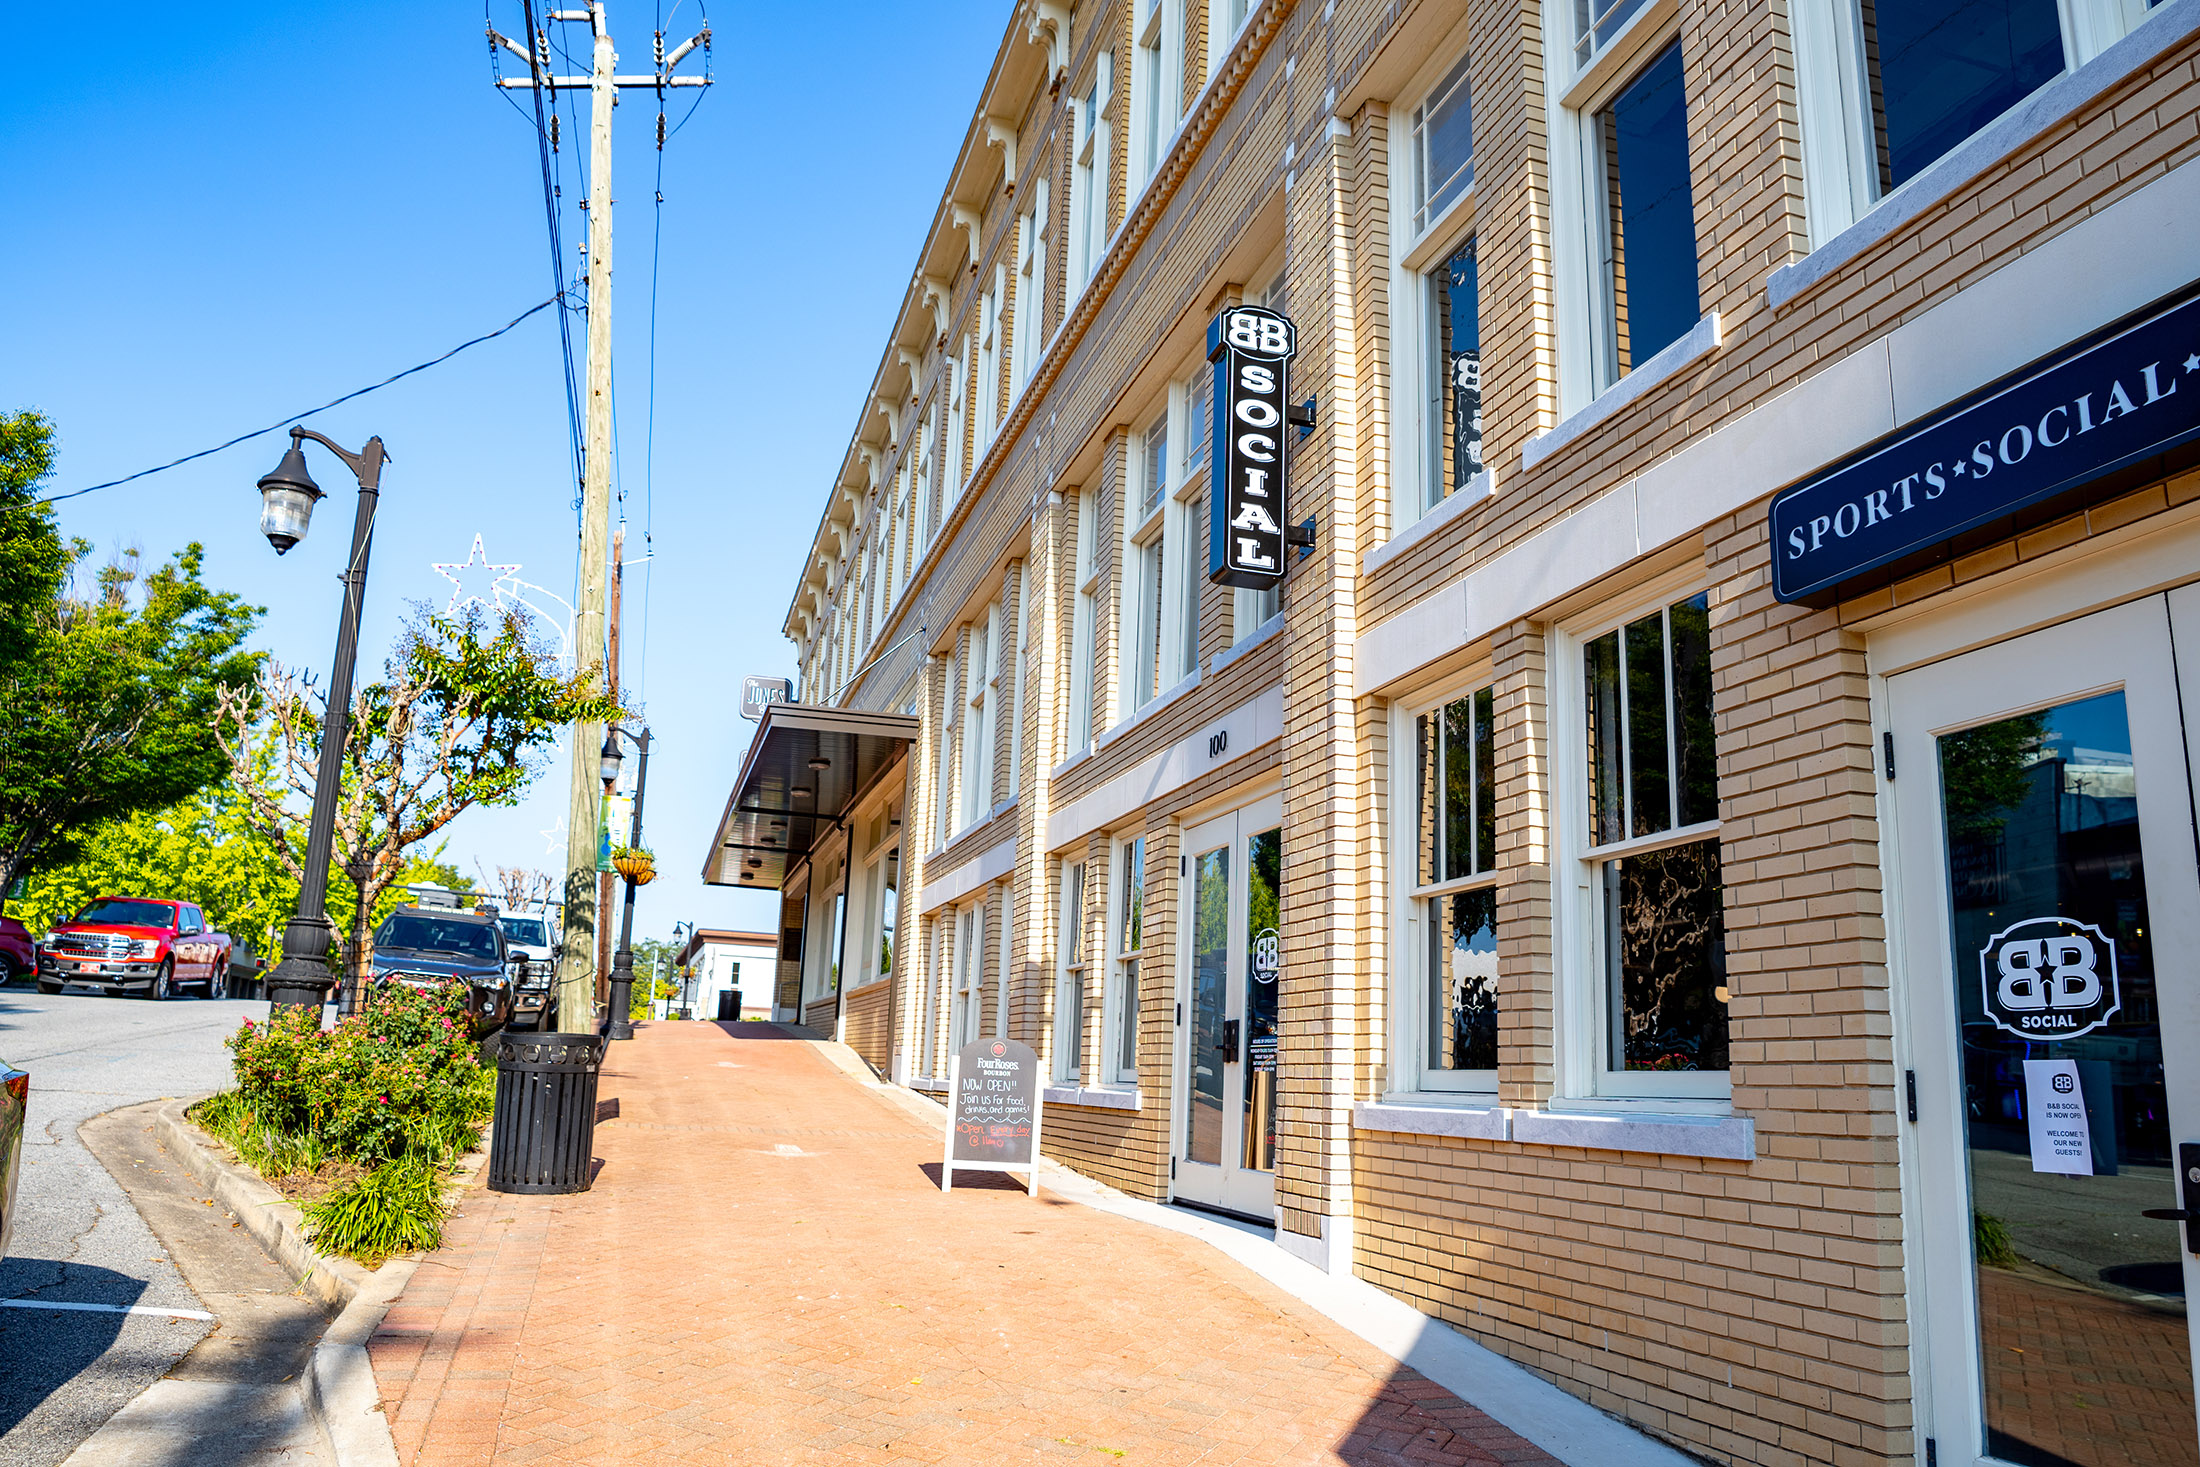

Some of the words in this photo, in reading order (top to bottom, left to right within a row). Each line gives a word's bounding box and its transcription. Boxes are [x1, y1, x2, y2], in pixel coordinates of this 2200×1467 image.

[1787, 462, 1946, 560] SPORTS
[1971, 361, 2177, 479] SOCIAL
[1231, 365, 1281, 570] SOCIAL
[746, 687, 785, 705] JONES
[1209, 730, 1227, 758] 100
[2021, 1015, 2077, 1028] SOCIAL
[983, 1069, 1011, 1077] BOURBON
[963, 1078, 983, 1091] NOW
[987, 1079, 1017, 1092] OPEN!!
[959, 1093, 979, 1105] Join
[981, 1096, 992, 1105] us
[990, 1106, 1003, 1114] and
[1016, 1124, 1031, 1136] day
[2046, 1130, 2079, 1138] WELCOME
